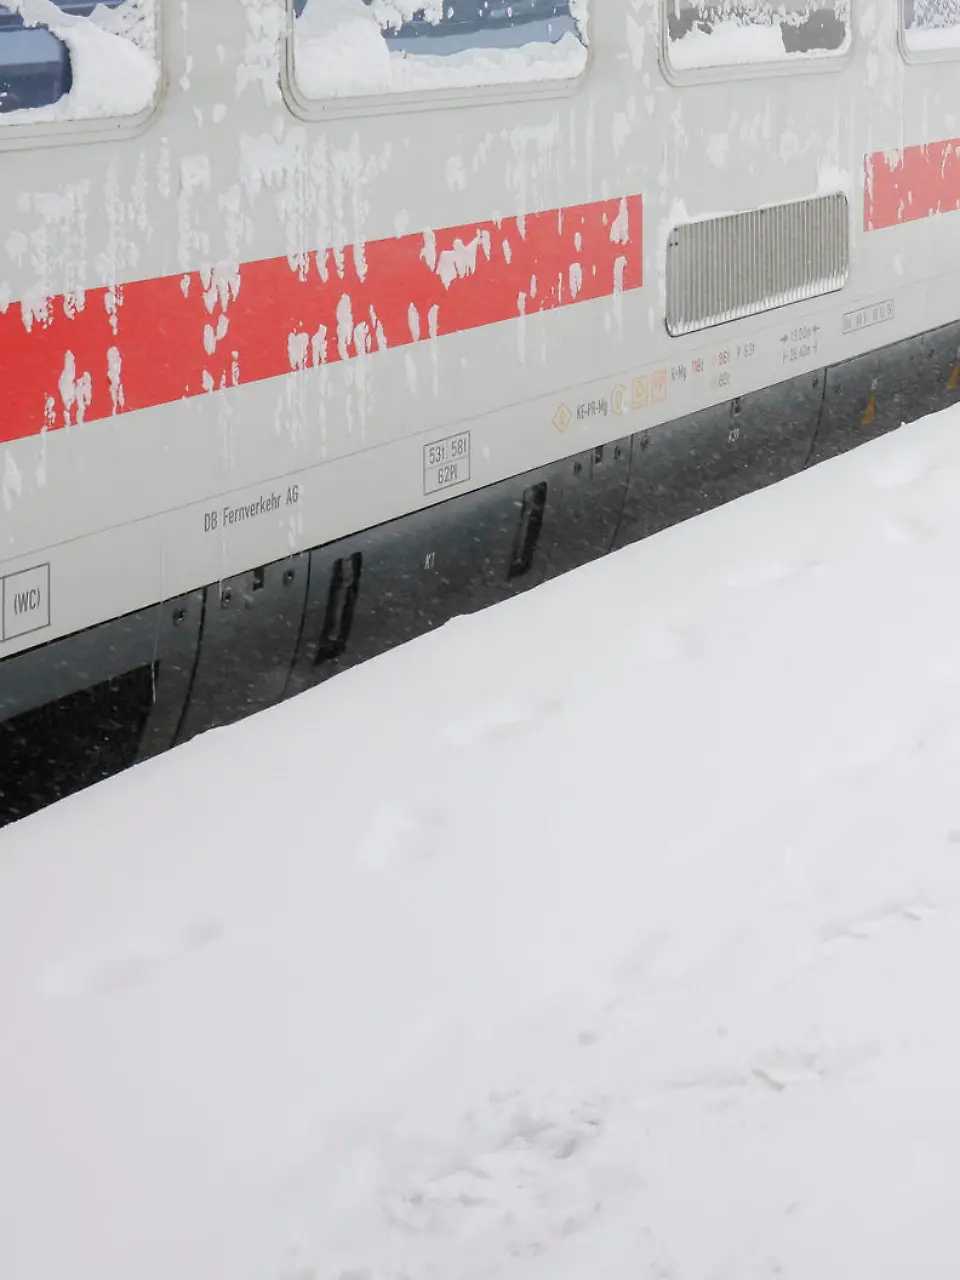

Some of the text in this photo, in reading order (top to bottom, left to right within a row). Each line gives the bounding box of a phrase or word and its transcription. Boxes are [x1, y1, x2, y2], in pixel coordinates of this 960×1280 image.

[204, 484, 299, 532] DB Fernverkehr AG
[14, 587, 41, 616] (WC)
